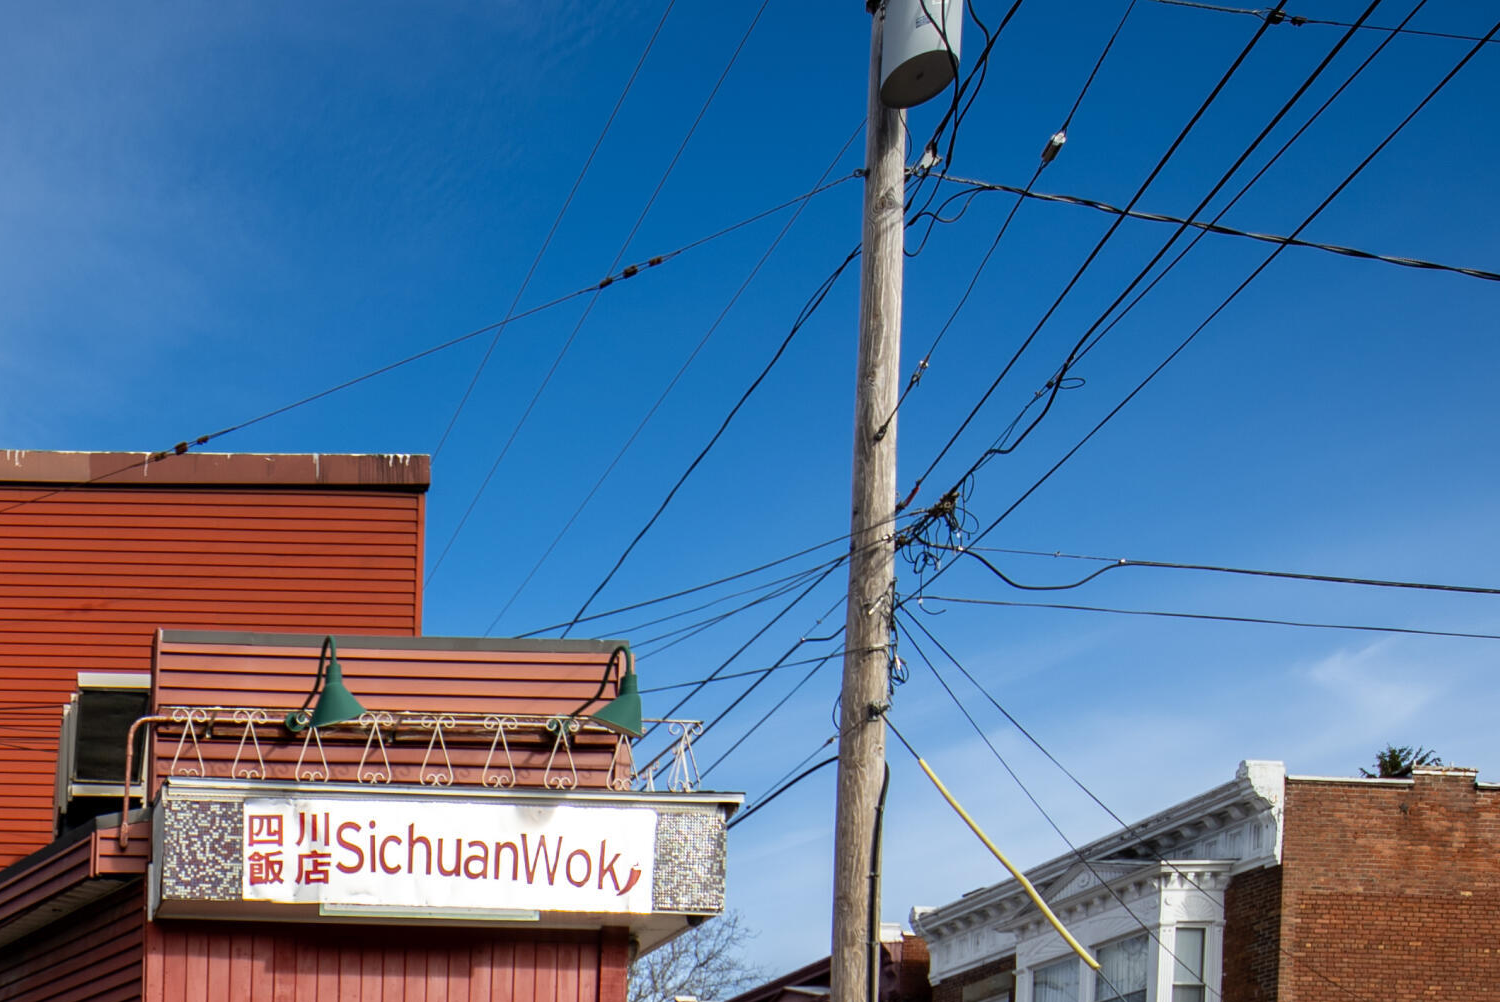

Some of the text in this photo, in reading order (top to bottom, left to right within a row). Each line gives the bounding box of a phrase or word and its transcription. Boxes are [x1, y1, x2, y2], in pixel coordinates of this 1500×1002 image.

[248, 812, 330, 846] 四川
[247, 850, 332, 885] 飯店
[336, 820, 621, 891] SichuanWok
